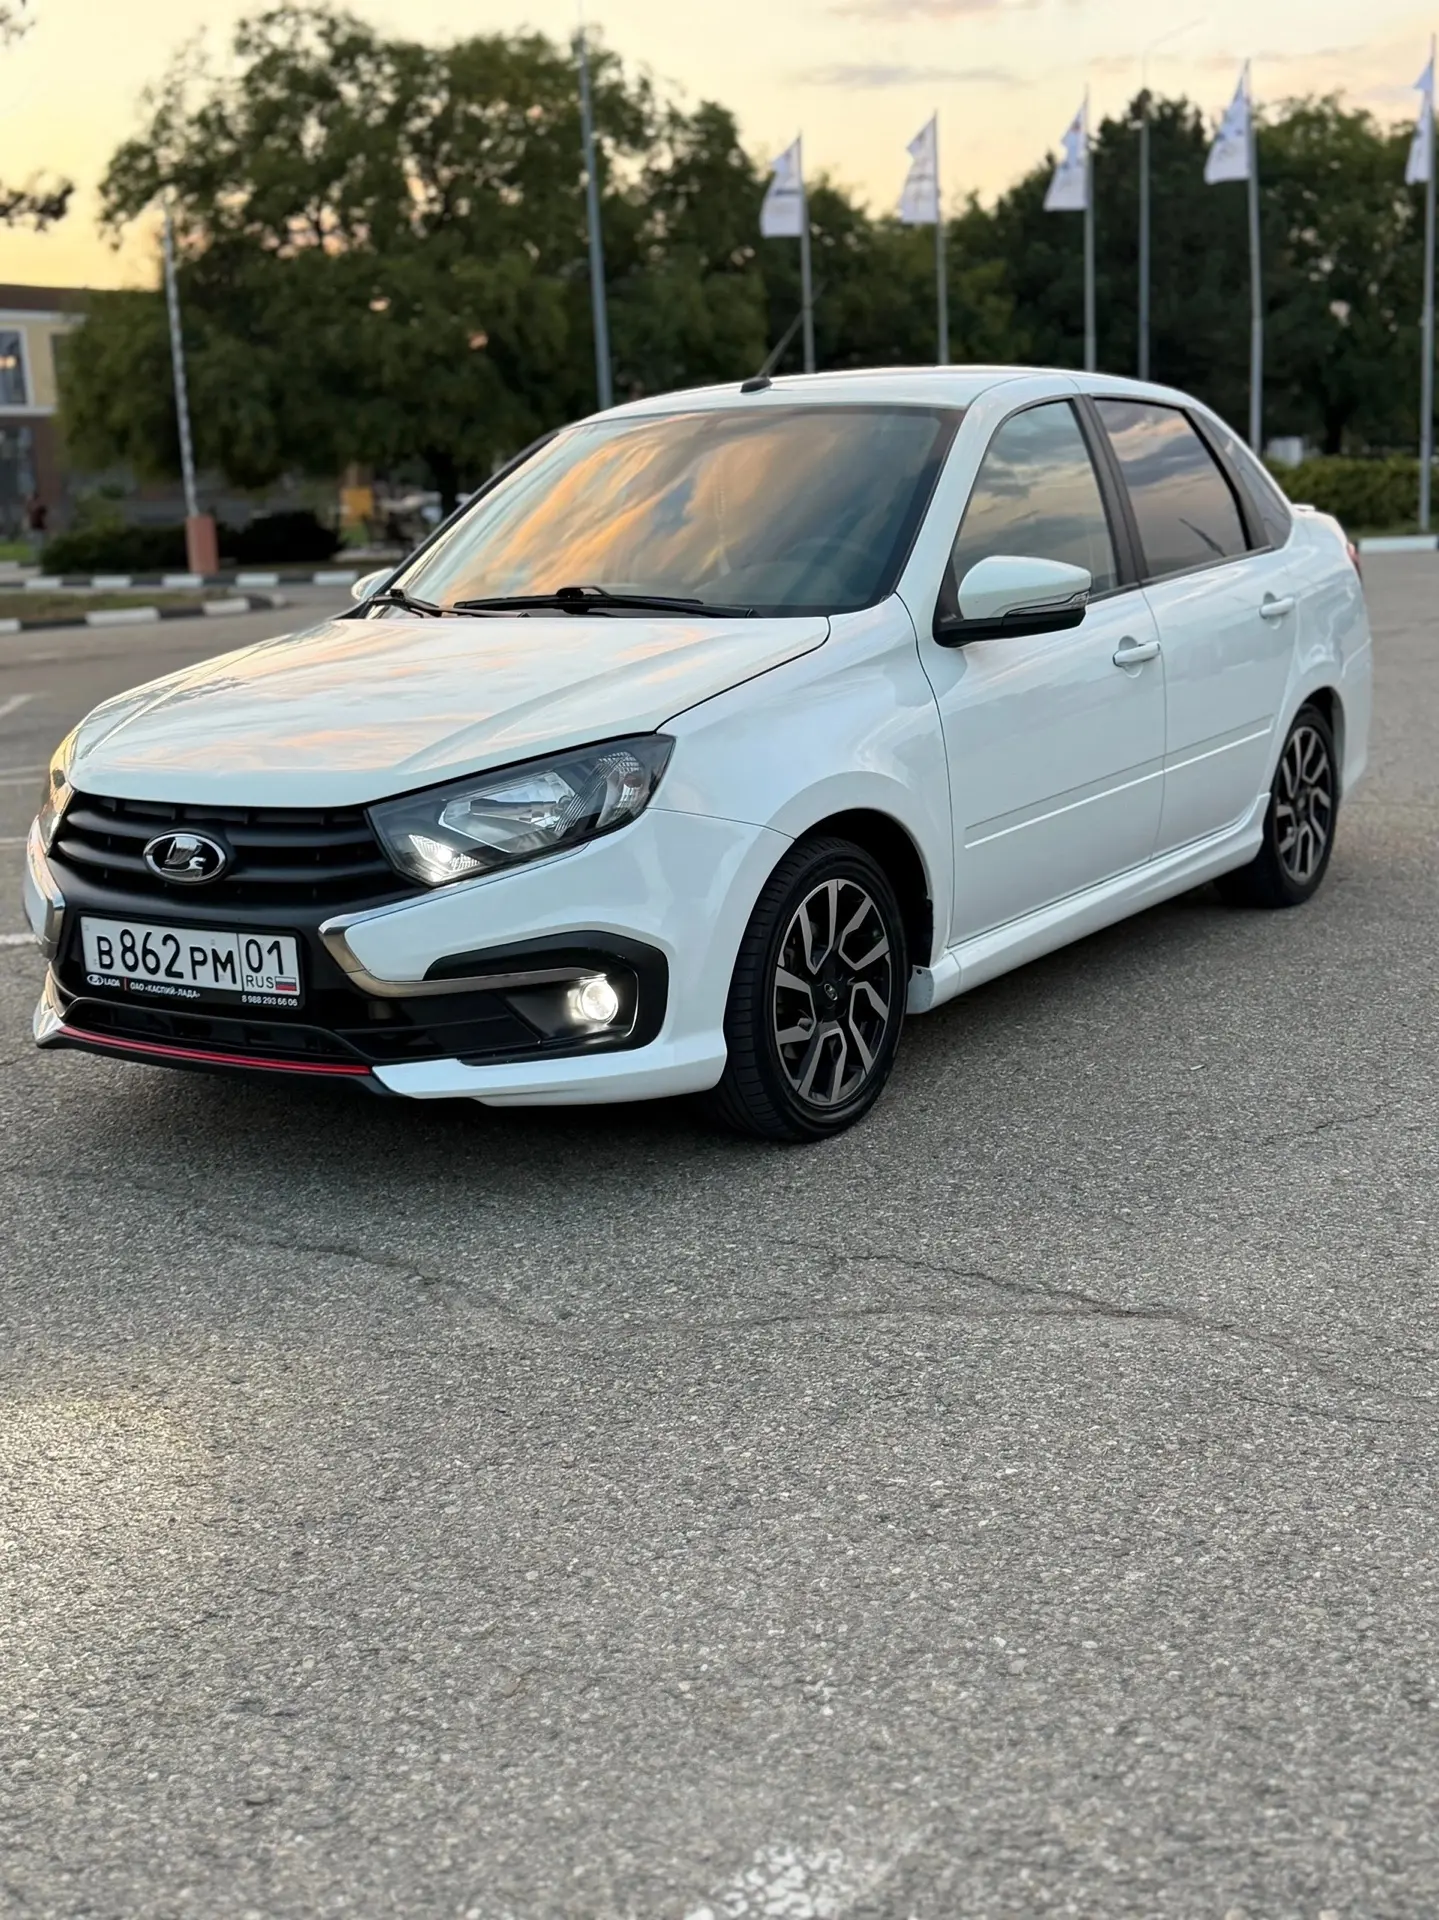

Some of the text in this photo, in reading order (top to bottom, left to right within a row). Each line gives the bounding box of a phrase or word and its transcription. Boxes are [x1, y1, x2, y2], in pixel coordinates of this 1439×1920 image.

[97, 929, 284, 984] В862РМ 01
[104, 978, 120, 986] LADA
[130, 982, 144, 991] ОАО
[246, 975, 274, 989] RUS
[241, 994, 247, 1003] 8
